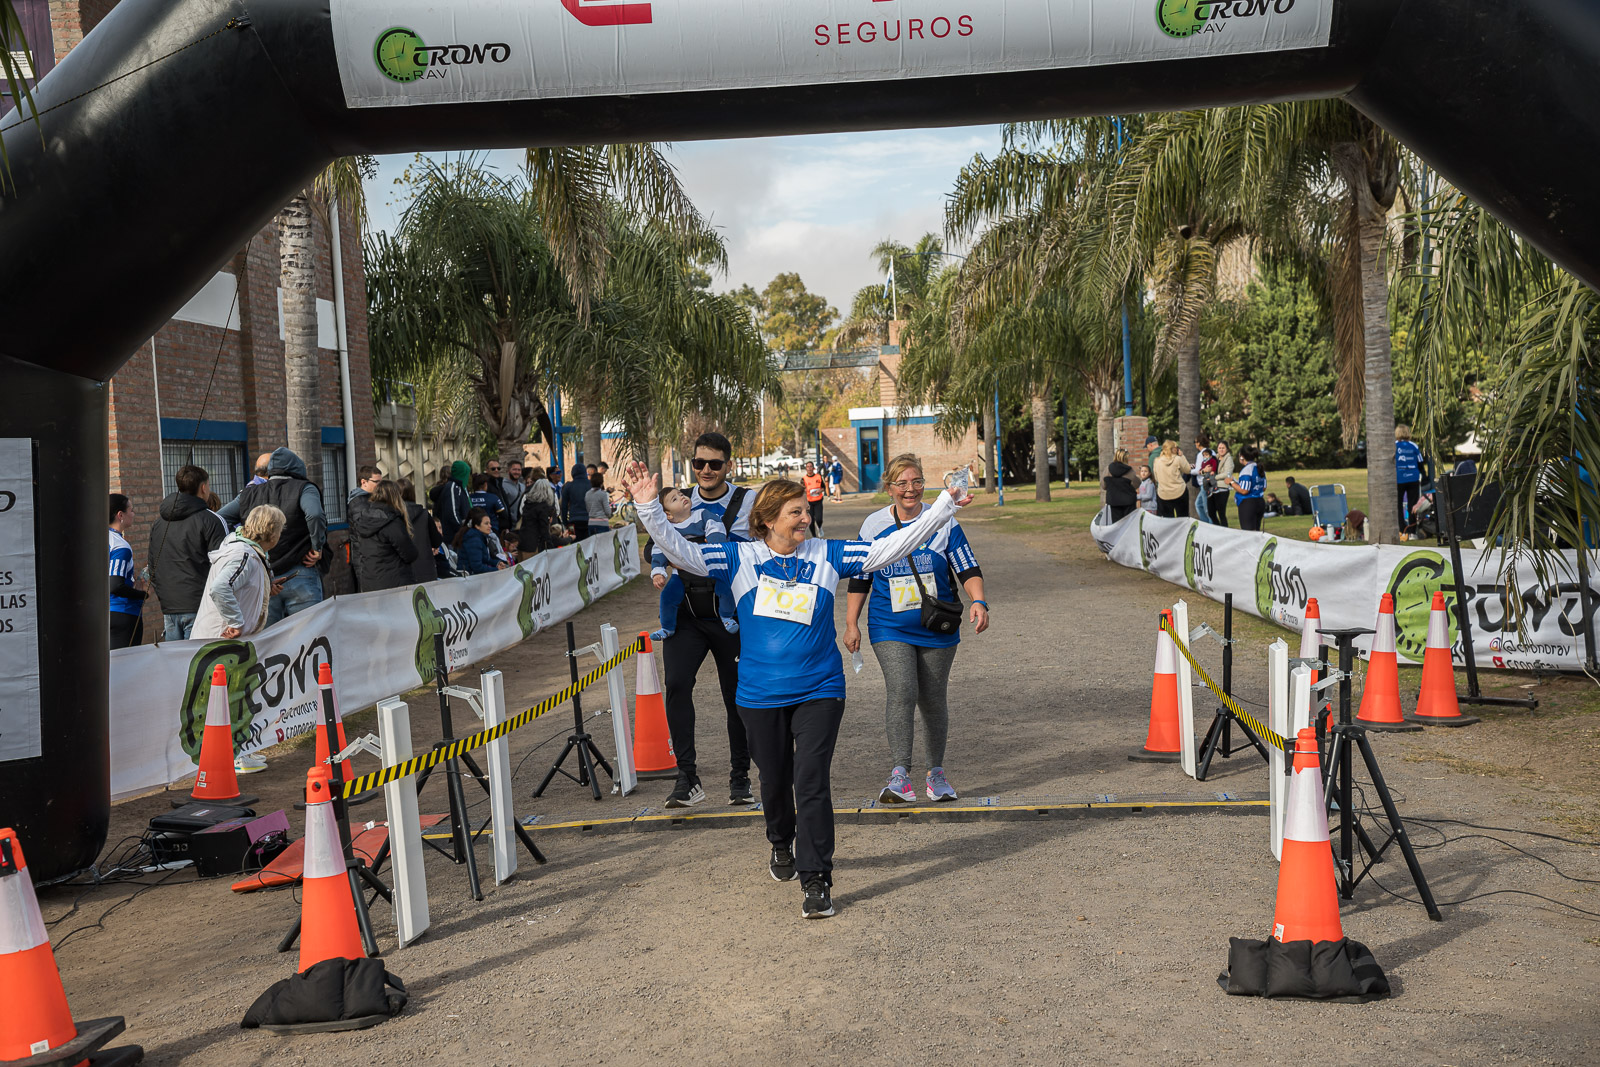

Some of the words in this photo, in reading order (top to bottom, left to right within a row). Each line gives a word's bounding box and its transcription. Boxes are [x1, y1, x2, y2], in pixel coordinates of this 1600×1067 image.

[814, 15, 974, 46] SEGUROS
[1191, 22, 1227, 35] RAV
[413, 43, 511, 66] CRONO
[413, 69, 448, 80] RAV
[761, 587, 809, 614] 702
